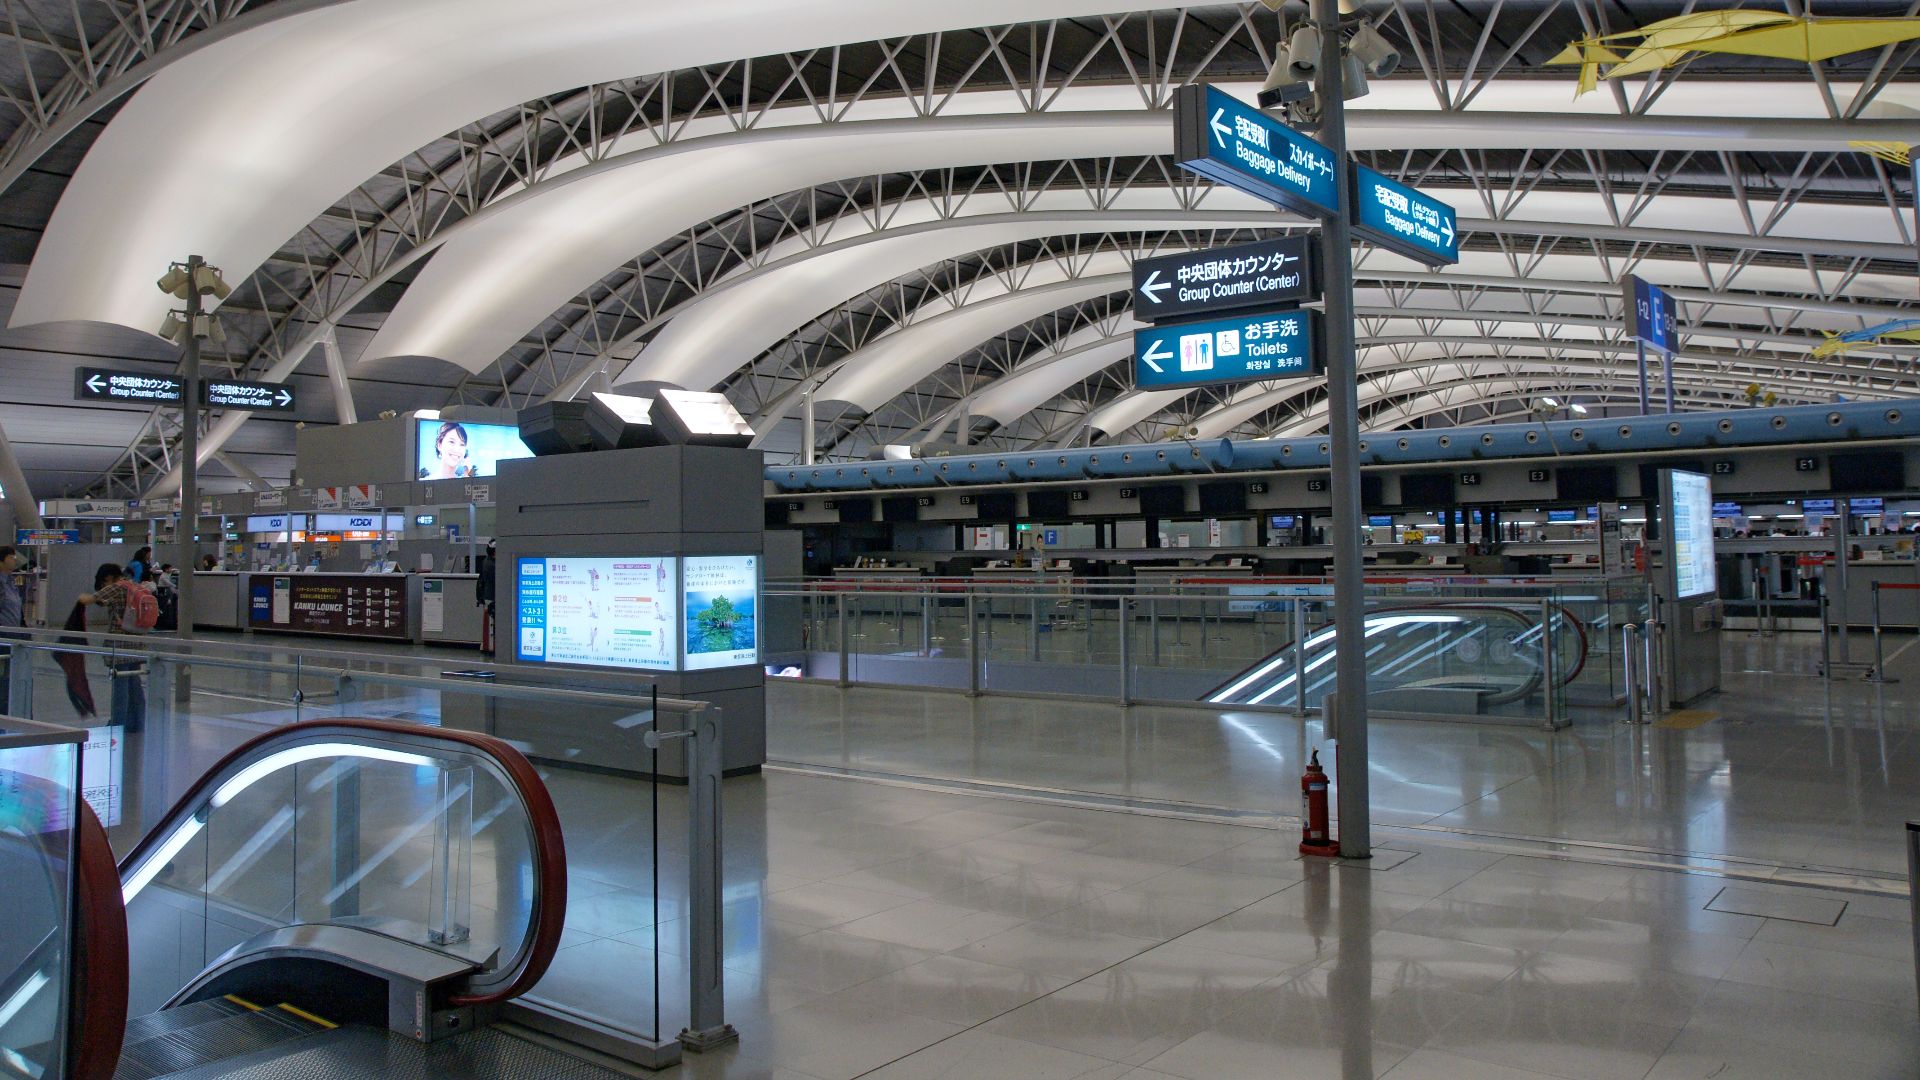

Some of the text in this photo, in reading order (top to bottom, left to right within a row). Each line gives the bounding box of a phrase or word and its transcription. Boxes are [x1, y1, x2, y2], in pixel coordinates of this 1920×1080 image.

[1236, 140, 1311, 193] Baggage Delivery
[1384, 208, 1441, 248] Baggage Delivery
[1177, 252, 1299, 284] 中央団体カウンター
[1178, 271, 1300, 303] Group Counter (Center)
[1653, 296, 1663, 337] E
[1244, 318, 1299, 340] お手洗
[1244, 341, 1289, 357] Toilets
[1245, 359, 1271, 371] 화장실
[110, 375, 180, 390] 中央団体カウンター
[110, 386, 130, 398] Group
[131, 388, 155, 399] Counter
[209, 384, 273, 396] 中央団体カウンター
[209, 394, 228, 404] Group
[228, 395, 250, 406] Counter
[1715, 463, 1731, 474] E2
[1799, 459, 1814, 470] E1
[1463, 474, 1476, 485] E4
[1531, 470, 1545, 482] E3
[425, 486, 433, 498] 20
[1252, 483, 1263, 493] E6
[1309, 482, 1321, 490] E5
[375, 489, 383, 501] 21
[1073, 491, 1082, 500] E8
[1121, 489, 1131, 498] E7
[961, 496, 970, 504] E9
[270, 519, 282, 528] KDDI
[350, 518, 373, 527] KDDI
[1047, 531, 1054, 543] F
[293, 601, 344, 613] KANKU LOUNGE
